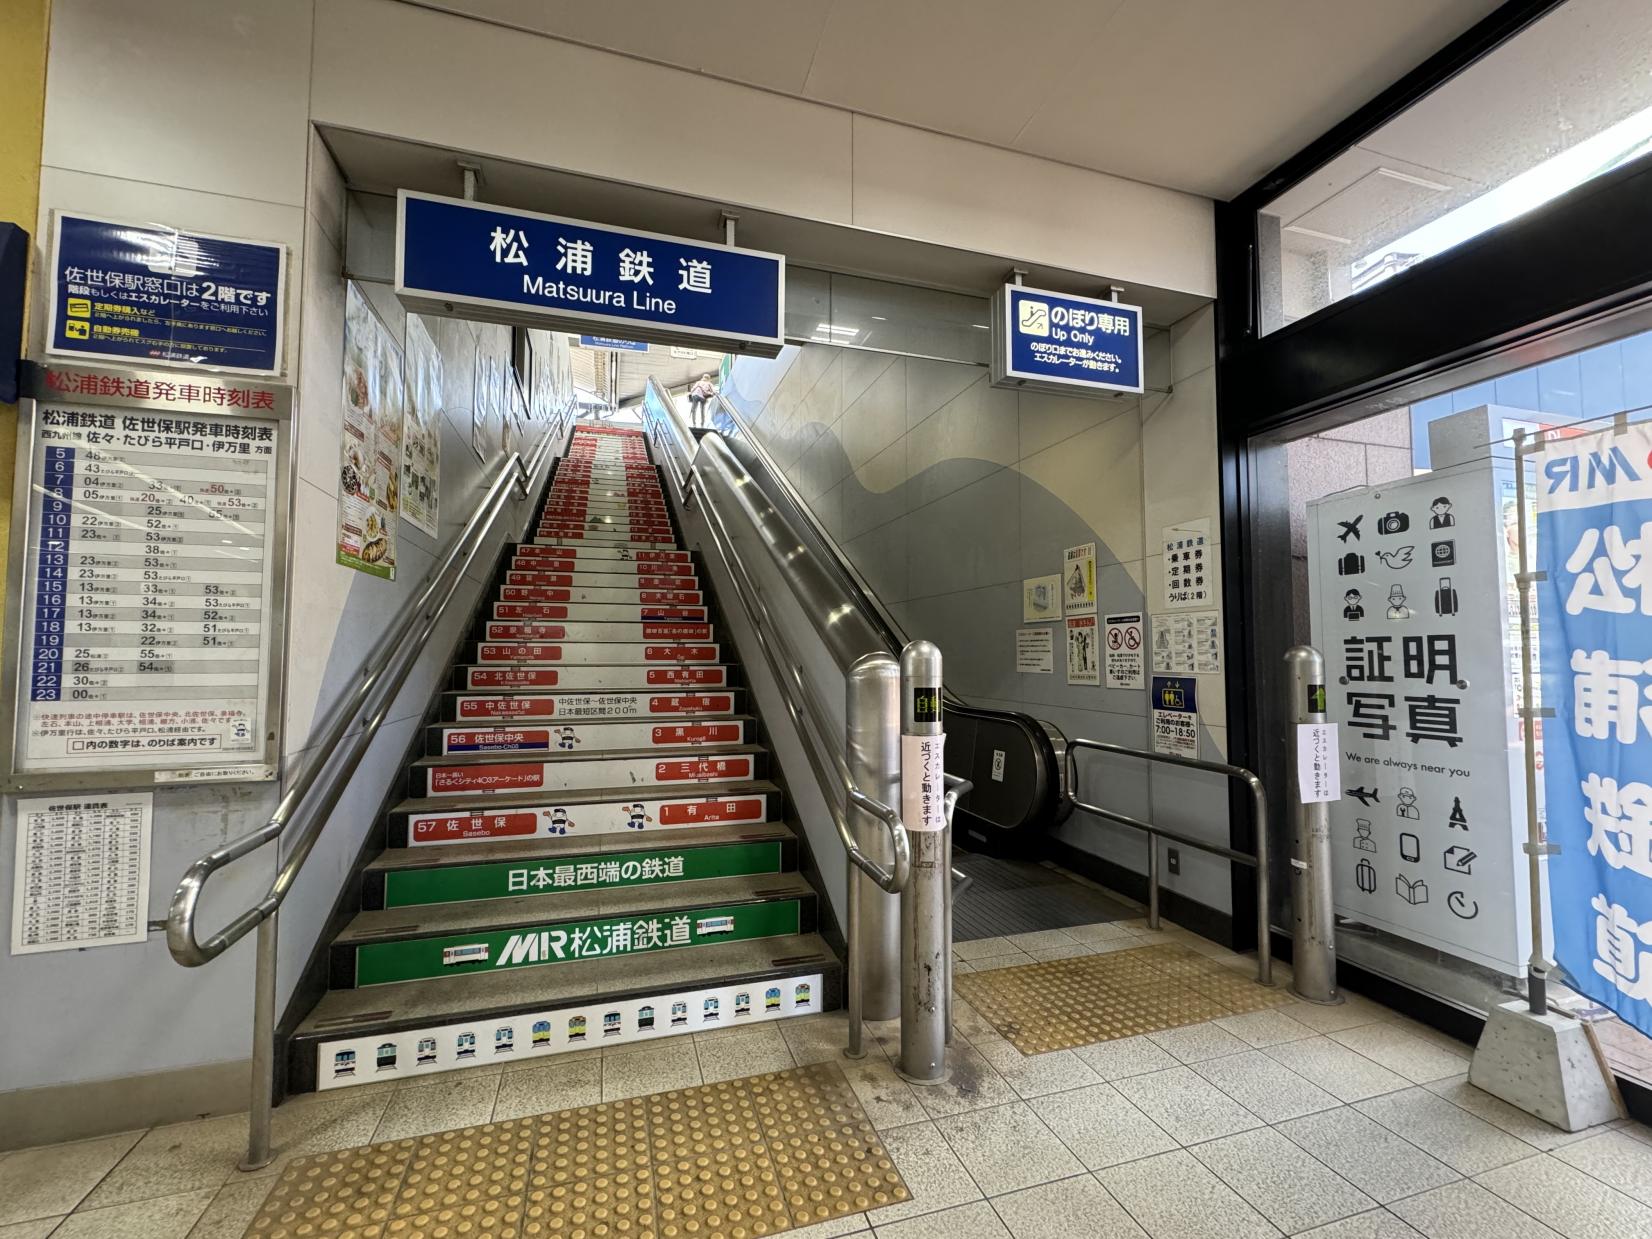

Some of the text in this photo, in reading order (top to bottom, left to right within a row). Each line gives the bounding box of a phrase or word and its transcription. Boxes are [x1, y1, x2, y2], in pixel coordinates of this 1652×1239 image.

[490, 226, 712, 294] 松浦鉄道
[65, 266, 271, 306] 佐世保駅窓口は2階です
[68, 284, 268, 316] 階段もしくはエスカレーターをご利用下さい
[523, 275, 676, 314] Matsuura Line
[1051, 307, 1130, 336] のぼり専用
[1052, 327, 1095, 345] Up Only
[1034, 352, 1119, 373] エスカレーターが動きます。
[45, 370, 274, 410] 松浦鉄道発車時刻表
[42, 409, 273, 441] 松浦鉄道 佐世保駅発車時刻表
[56, 449, 65, 458] 5
[255, 446, 272, 454] 方面
[55, 462, 100, 473] 6 43
[55, 475, 63, 484] 7
[84, 477, 99, 486] 04
[210, 485, 224, 493] 50
[83, 490, 98, 499] 05
[140, 493, 155, 502] 20
[228, 498, 241, 506] 53
[53, 501, 162, 515] 9 25
[48, 515, 162, 528] 10 22 52
[48, 528, 160, 541] 11 23 53
[145, 545, 159, 554] 38
[1167, 537, 1204, 551] 松浦鉄道
[46, 555, 159, 567] 13 23 53
[45, 568, 158, 580] 14 23 53
[45, 582, 219, 594] 15 13 33 53
[43, 595, 219, 607] 16 13 34 53
[43, 608, 218, 620] 17 13 34 52
[42, 622, 216, 633] 18 13 32 51
[491, 626, 504, 634] 52
[41, 635, 216, 646] 19 22 51
[39, 649, 155, 659] 20 25 55
[1343, 634, 1458, 685] 証明
[38, 662, 153, 672] 21 26 54
[37, 676, 88, 686] 22 30
[494, 672, 536, 680] 北佐世保
[650, 671, 655, 679] 5
[36, 690, 88, 700] 23 00
[463, 701, 531, 710] 55 中佐世保
[1346, 692, 1464, 748] 写真
[655, 726, 718, 737] 3 黒川
[450, 733, 524, 744] 56 佐世保中央
[658, 762, 726, 773] 2 三代橋
[1312, 728, 1321, 798] 近づくと動きます
[1346, 751, 1471, 778] We are always near you
[921, 741, 932, 826] 近づくと動きます
[664, 803, 736, 816] 1 有田
[417, 817, 507, 832] 57 佐世保
[508, 856, 685, 892] 日本最西端の鉄道
[570, 915, 692, 958] 松浦鉄道
